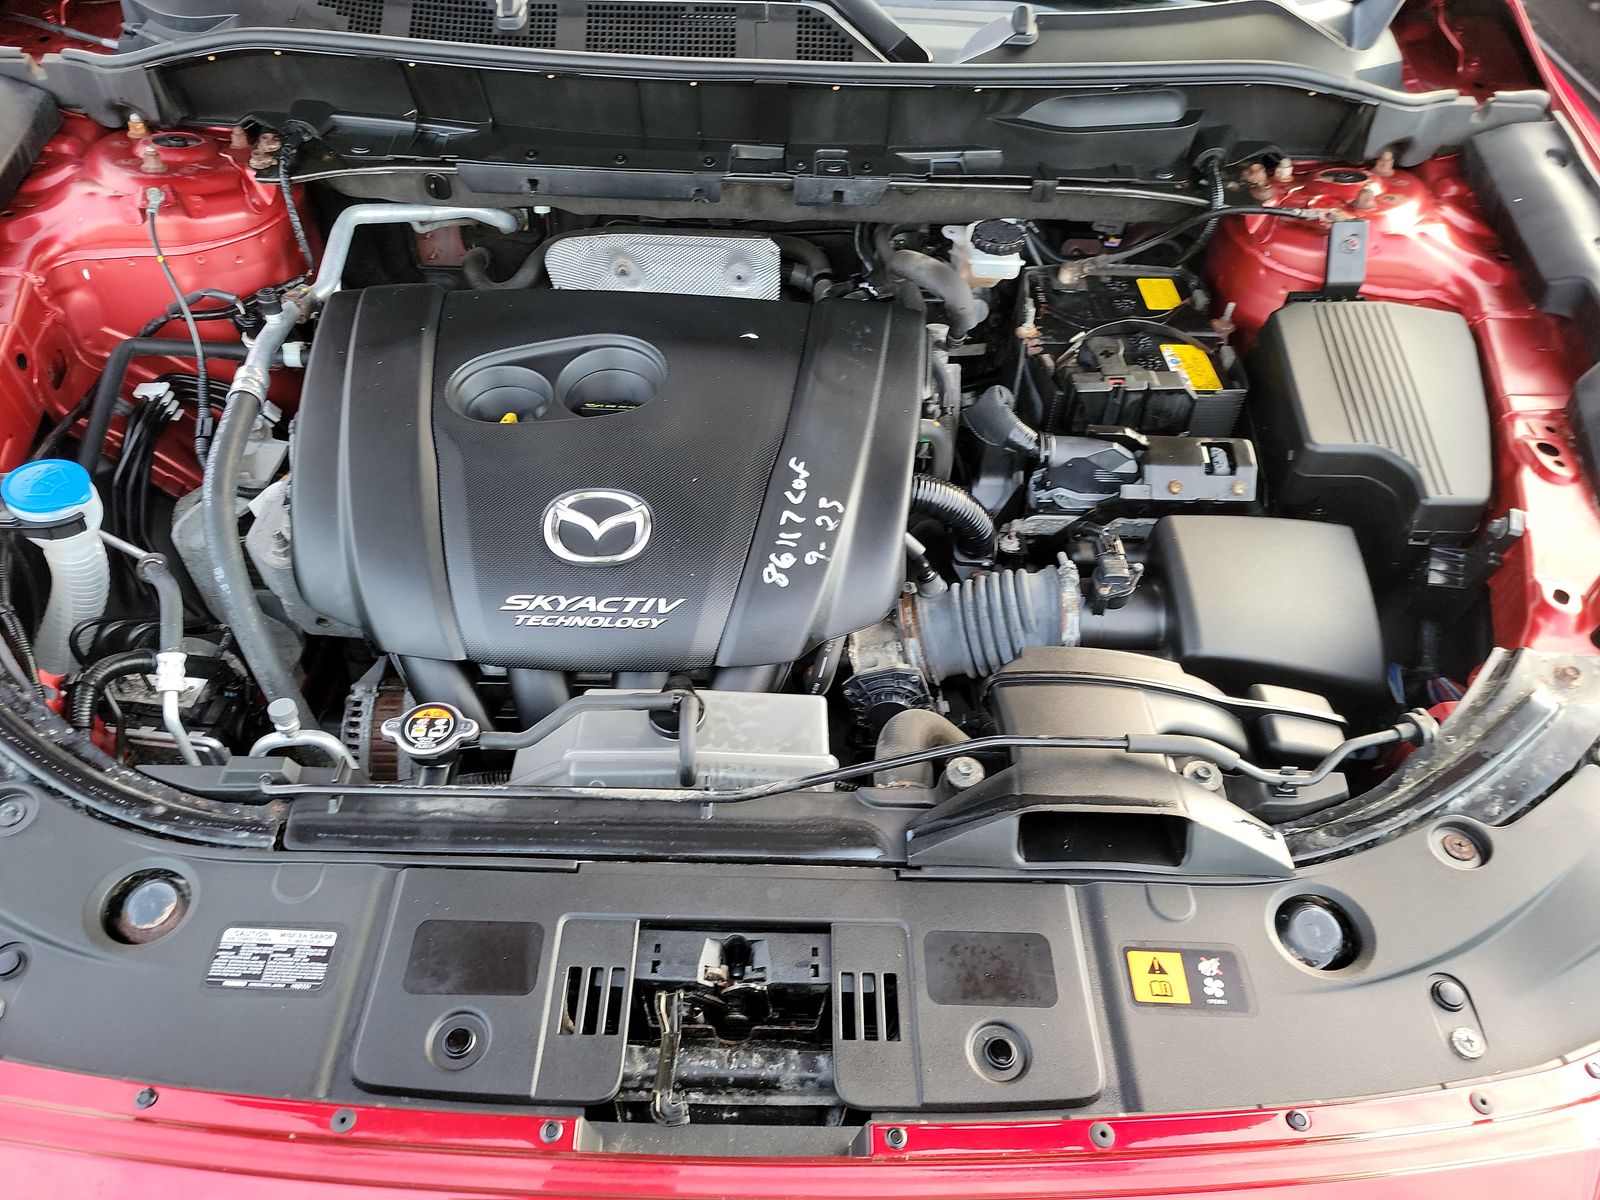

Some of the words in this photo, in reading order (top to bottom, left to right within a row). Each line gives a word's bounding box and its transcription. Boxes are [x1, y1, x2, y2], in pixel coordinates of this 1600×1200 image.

[762, 510, 806, 587] 86117
[500, 594, 687, 613] SKYACTIV
[514, 614, 668, 629] TECHNOLOGY
